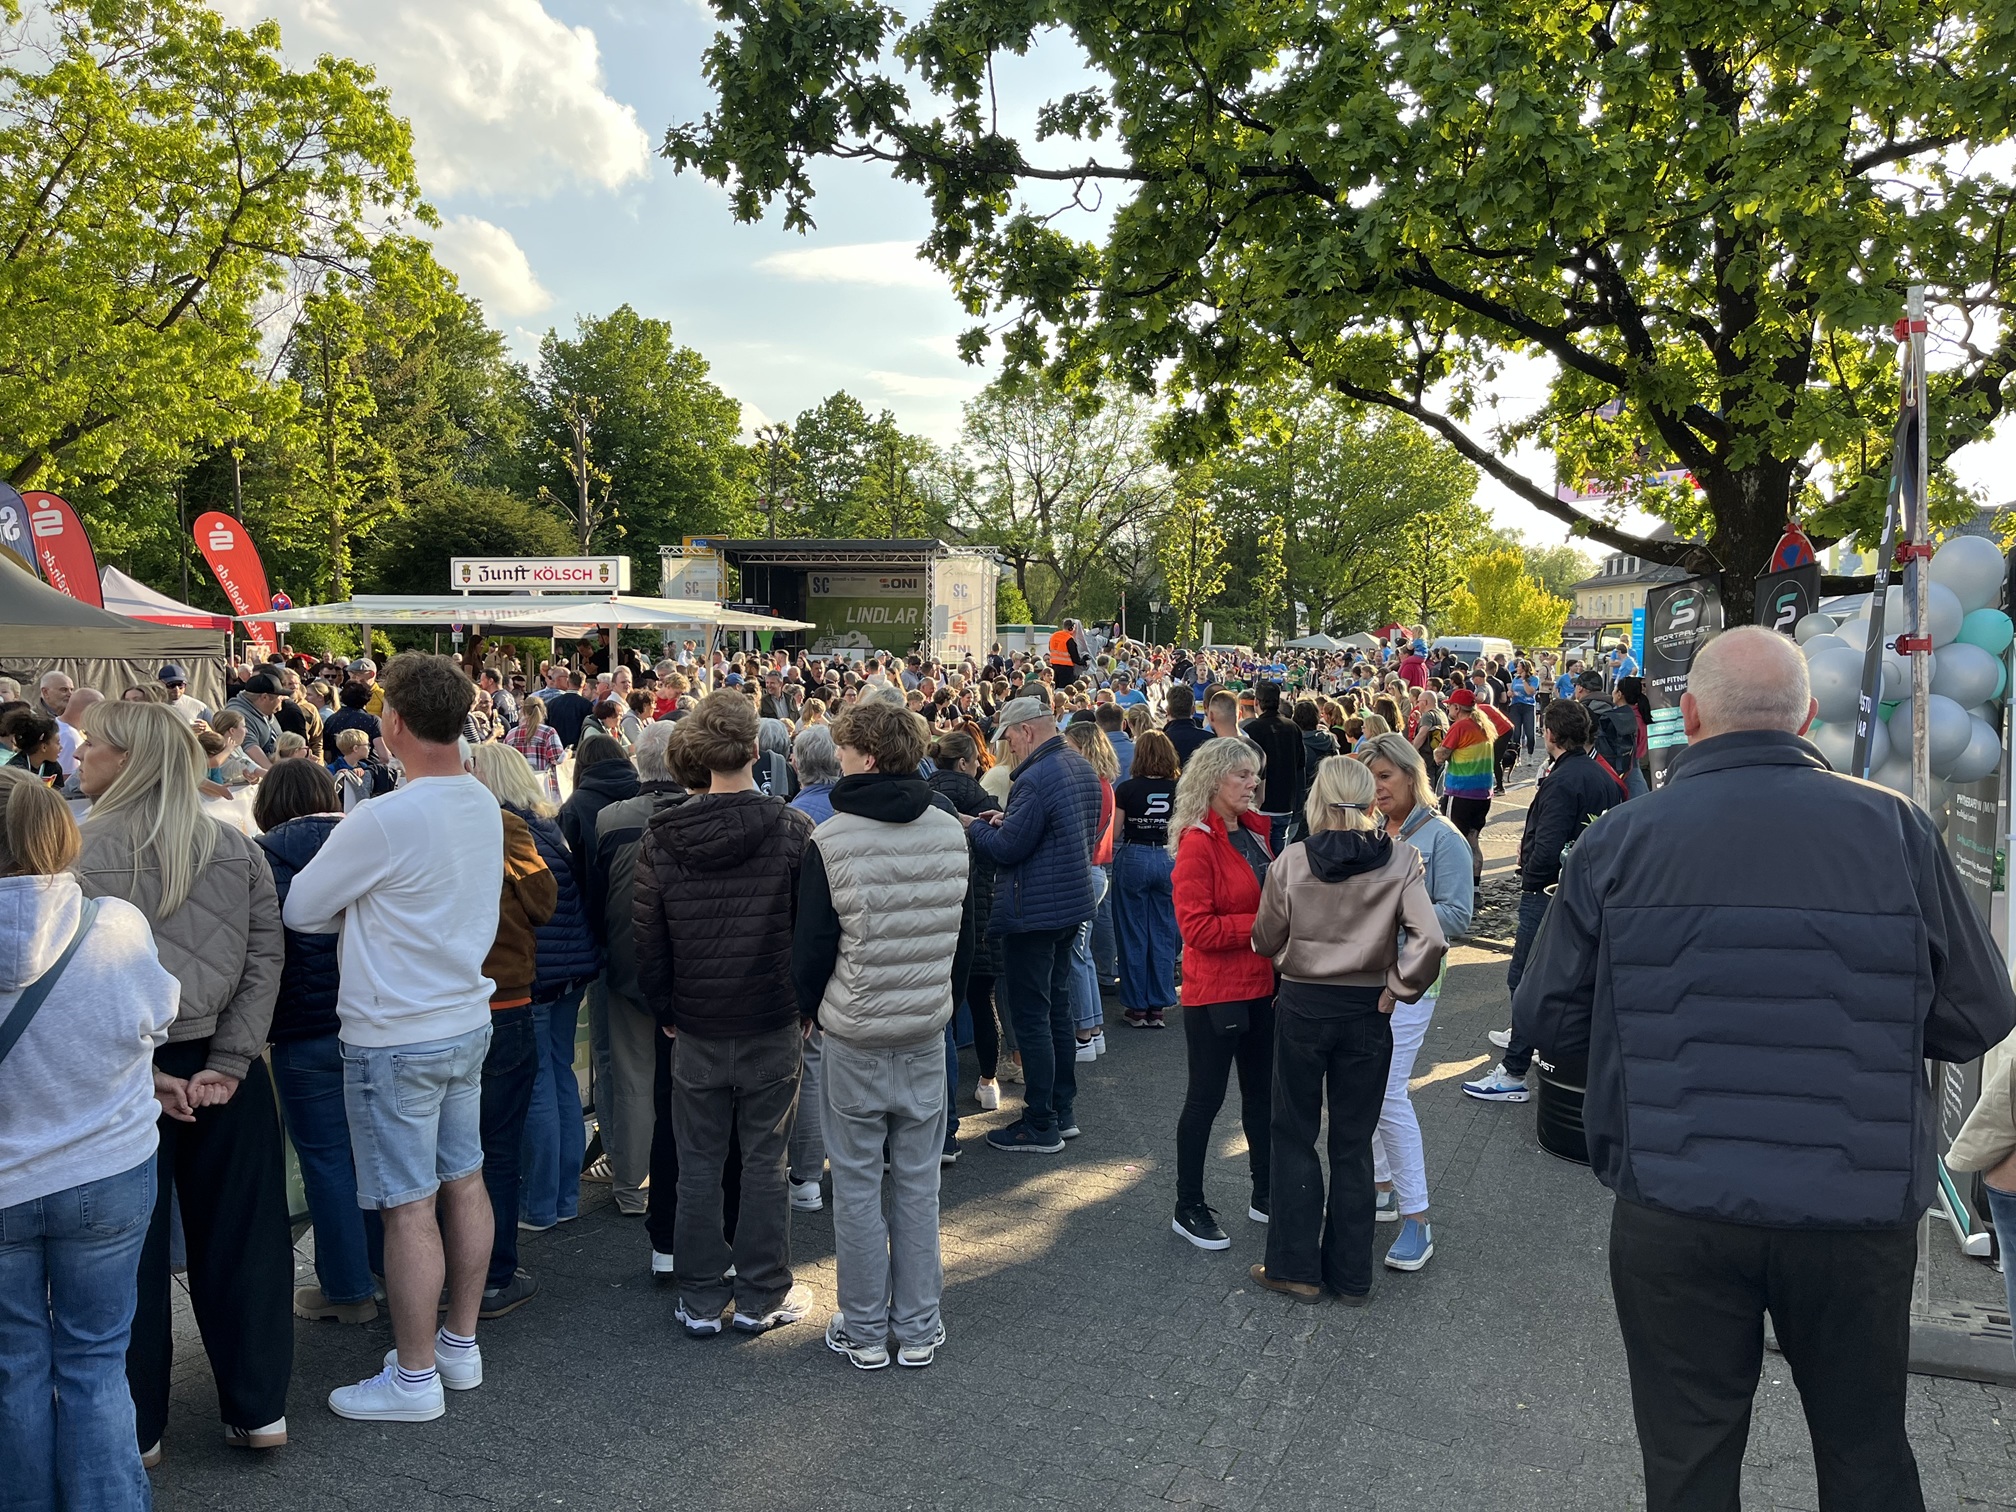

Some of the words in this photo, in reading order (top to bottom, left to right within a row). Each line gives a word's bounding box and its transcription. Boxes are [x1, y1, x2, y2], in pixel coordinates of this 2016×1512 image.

[478, 565, 531, 582] Zunft
[533, 566, 593, 581] KÖLSCH
[685, 581, 699, 595] SC
[813, 577, 830, 594] SC
[891, 578, 917, 589] ONI
[953, 583, 968, 598] SC
[846, 606, 918, 624] LINDLAR
[1652, 678, 1666, 687] DEIN
[1664, 685, 1673, 693] IN
